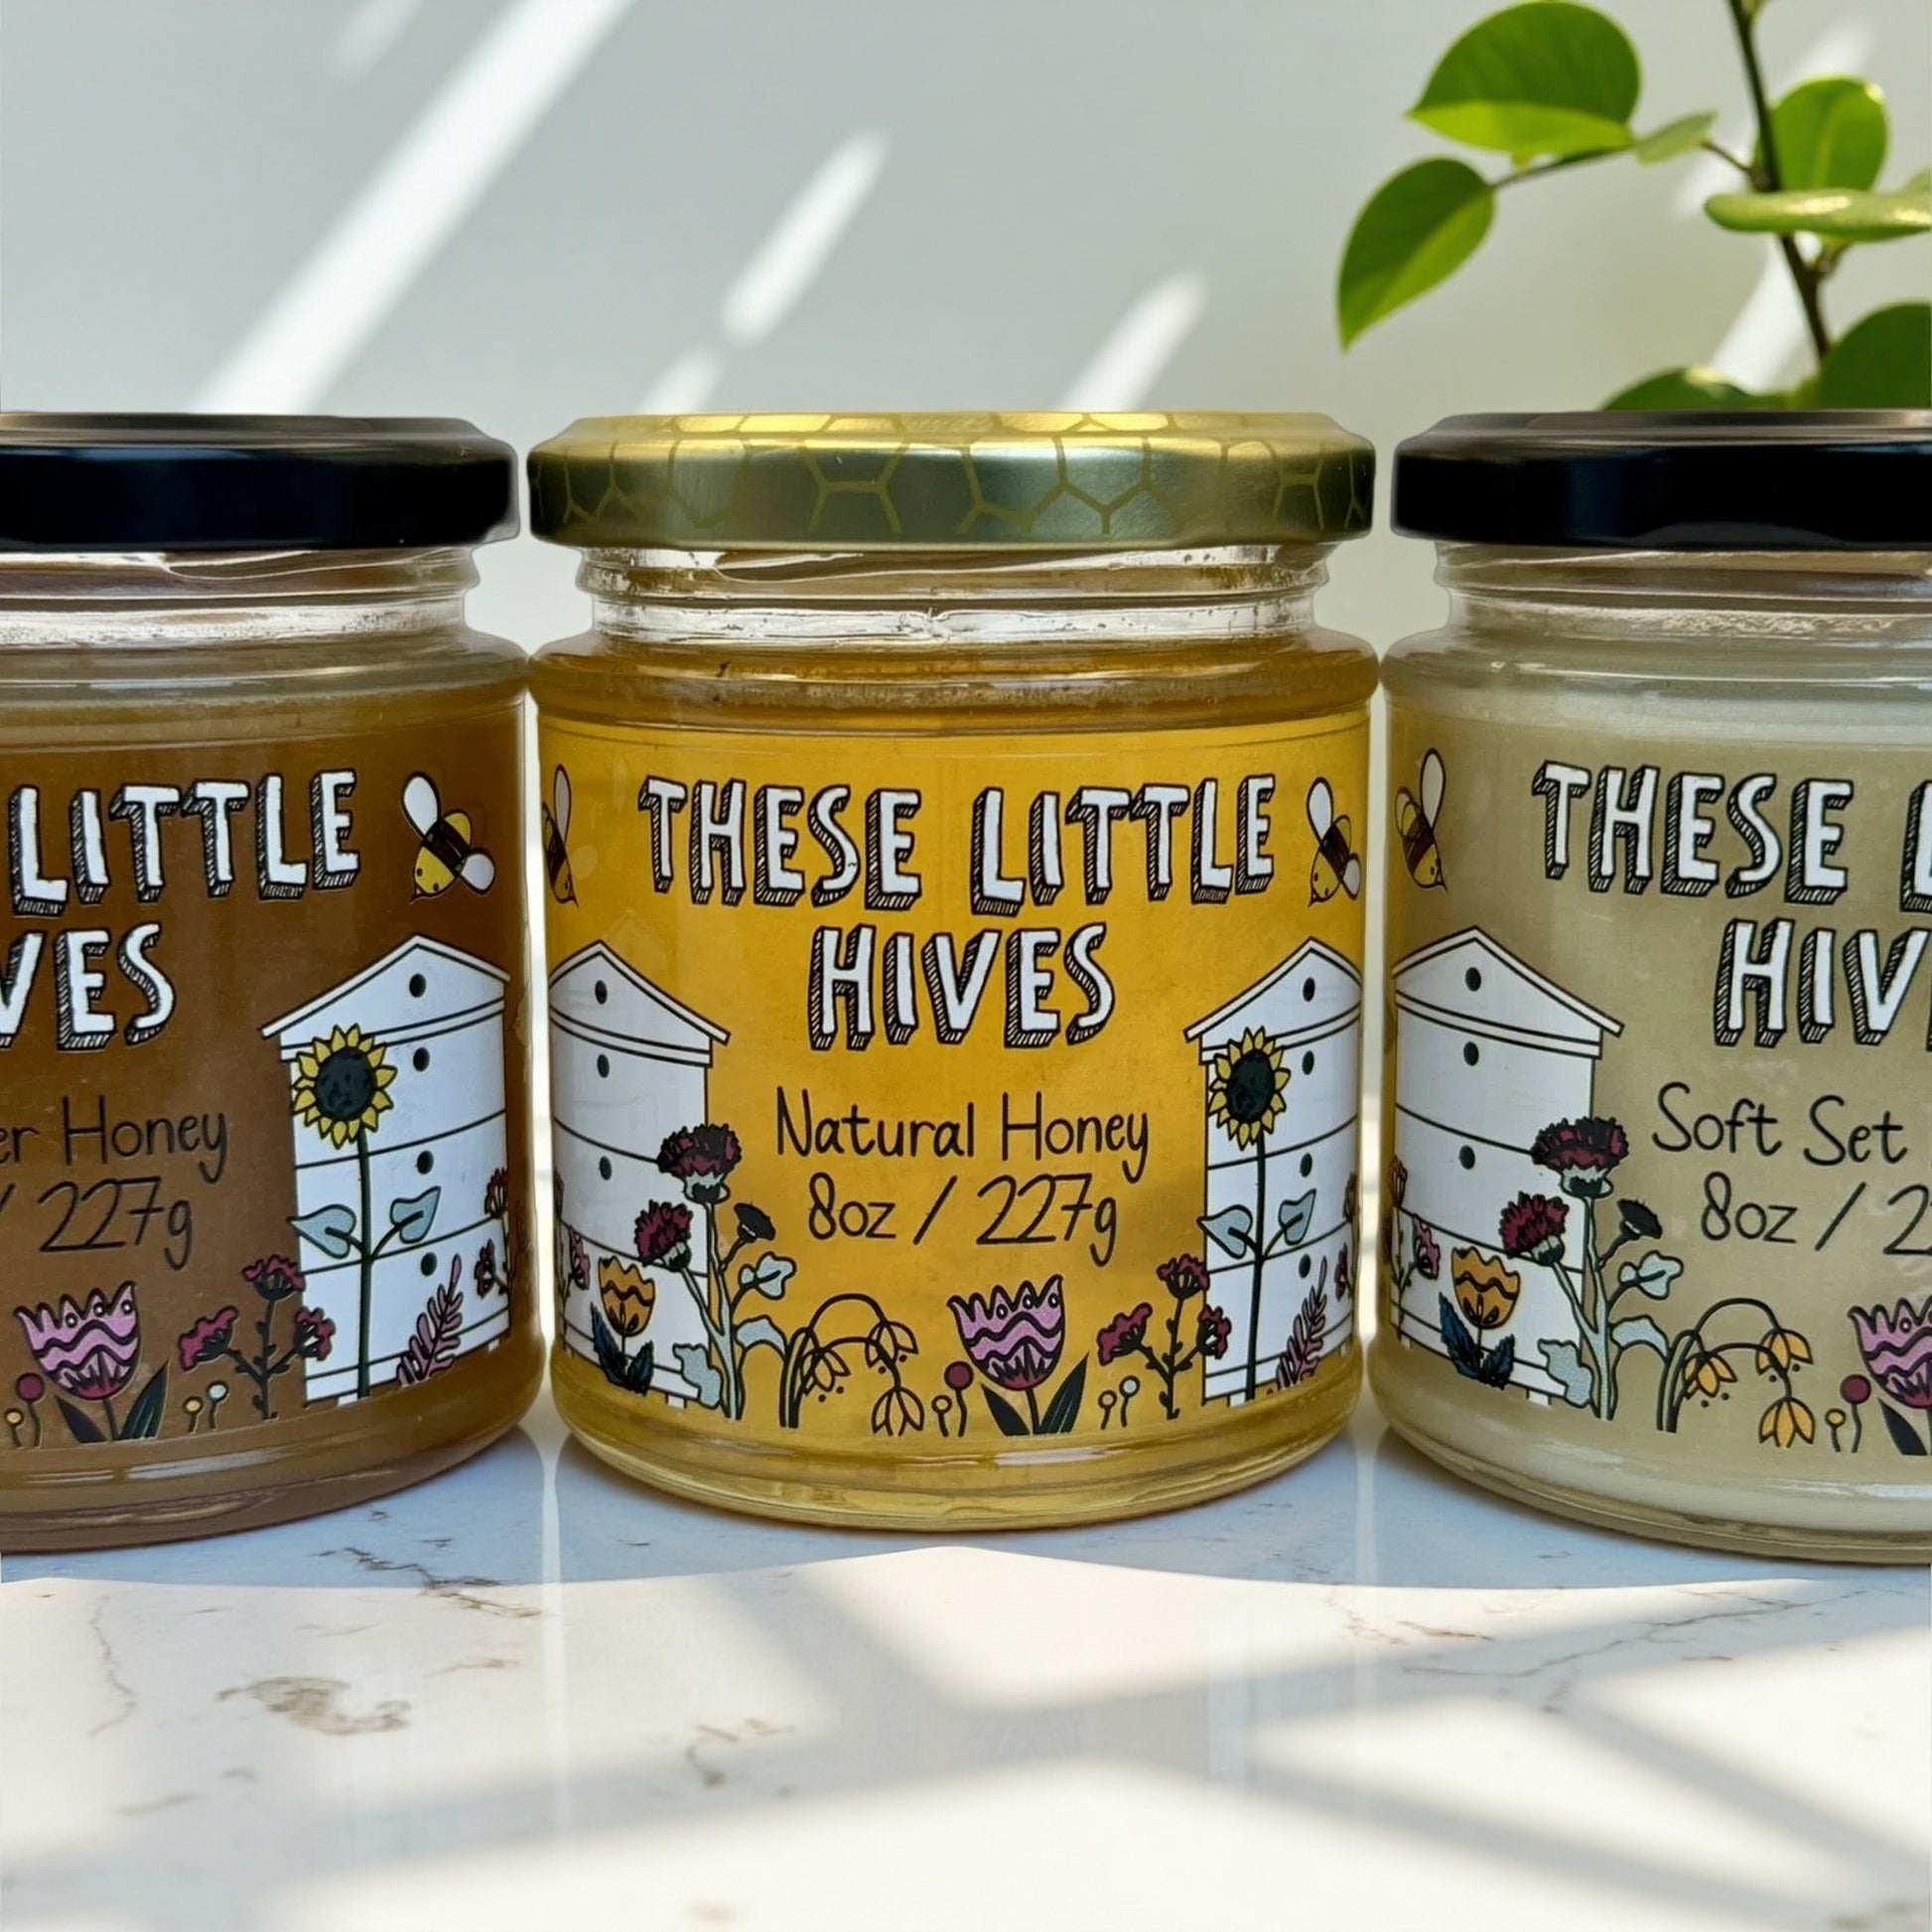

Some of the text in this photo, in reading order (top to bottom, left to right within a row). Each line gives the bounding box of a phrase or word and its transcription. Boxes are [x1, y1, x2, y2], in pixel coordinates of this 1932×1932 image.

[8, 767, 361, 917] LITTLE
[638, 774, 1275, 917] THESE LITTLE
[1532, 759, 1855, 905] THESE
[808, 923, 1115, 1050] HIVES
[1715, 917, 1932, 1051] HIV
[63, 1095, 228, 1184] Honey
[776, 1085, 1150, 1184] Natural Honey
[1652, 1081, 1908, 1167] Soft Set
[39, 1175, 194, 1272] 227g
[807, 1172, 1118, 1268] 8oz / 227g
[1701, 1171, 1932, 1256] 8oz / 2
